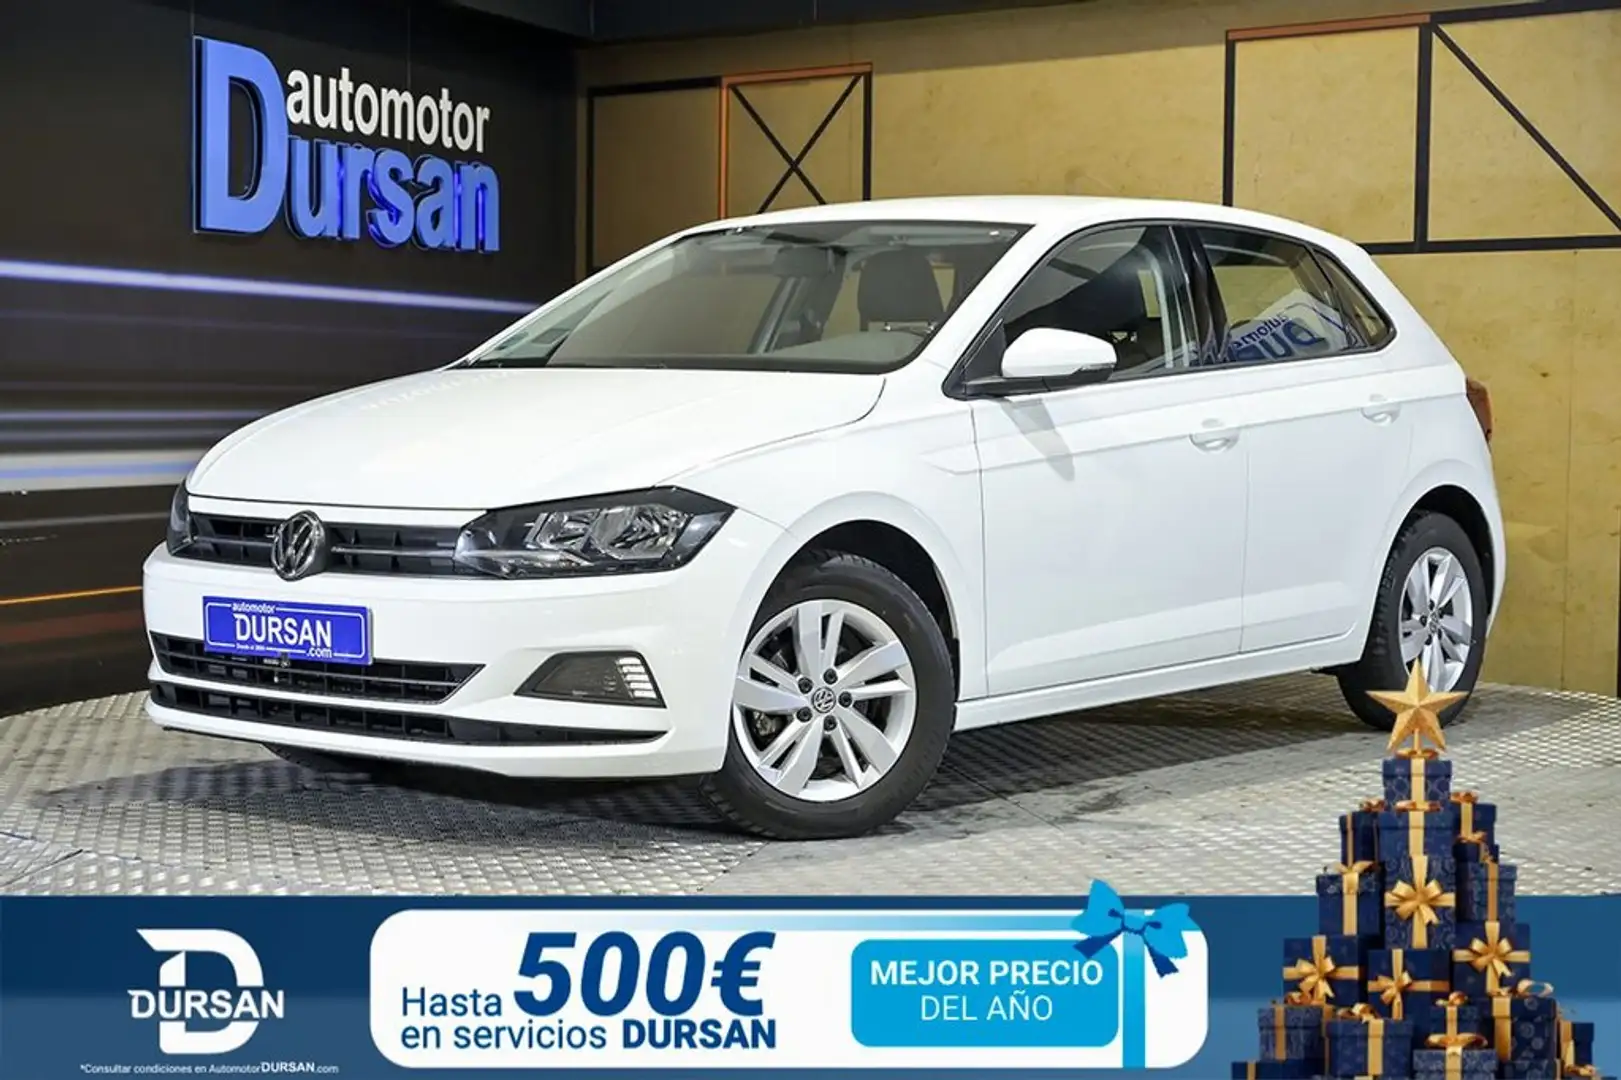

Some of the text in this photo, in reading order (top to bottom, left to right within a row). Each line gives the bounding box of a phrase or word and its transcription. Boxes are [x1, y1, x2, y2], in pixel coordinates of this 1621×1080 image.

[286, 67, 490, 152] automotor
[193, 35, 500, 252] Dursan
[232, 602, 276, 614] automotor
[233, 613, 332, 648] DURSAN
[306, 646, 333, 659] .com
